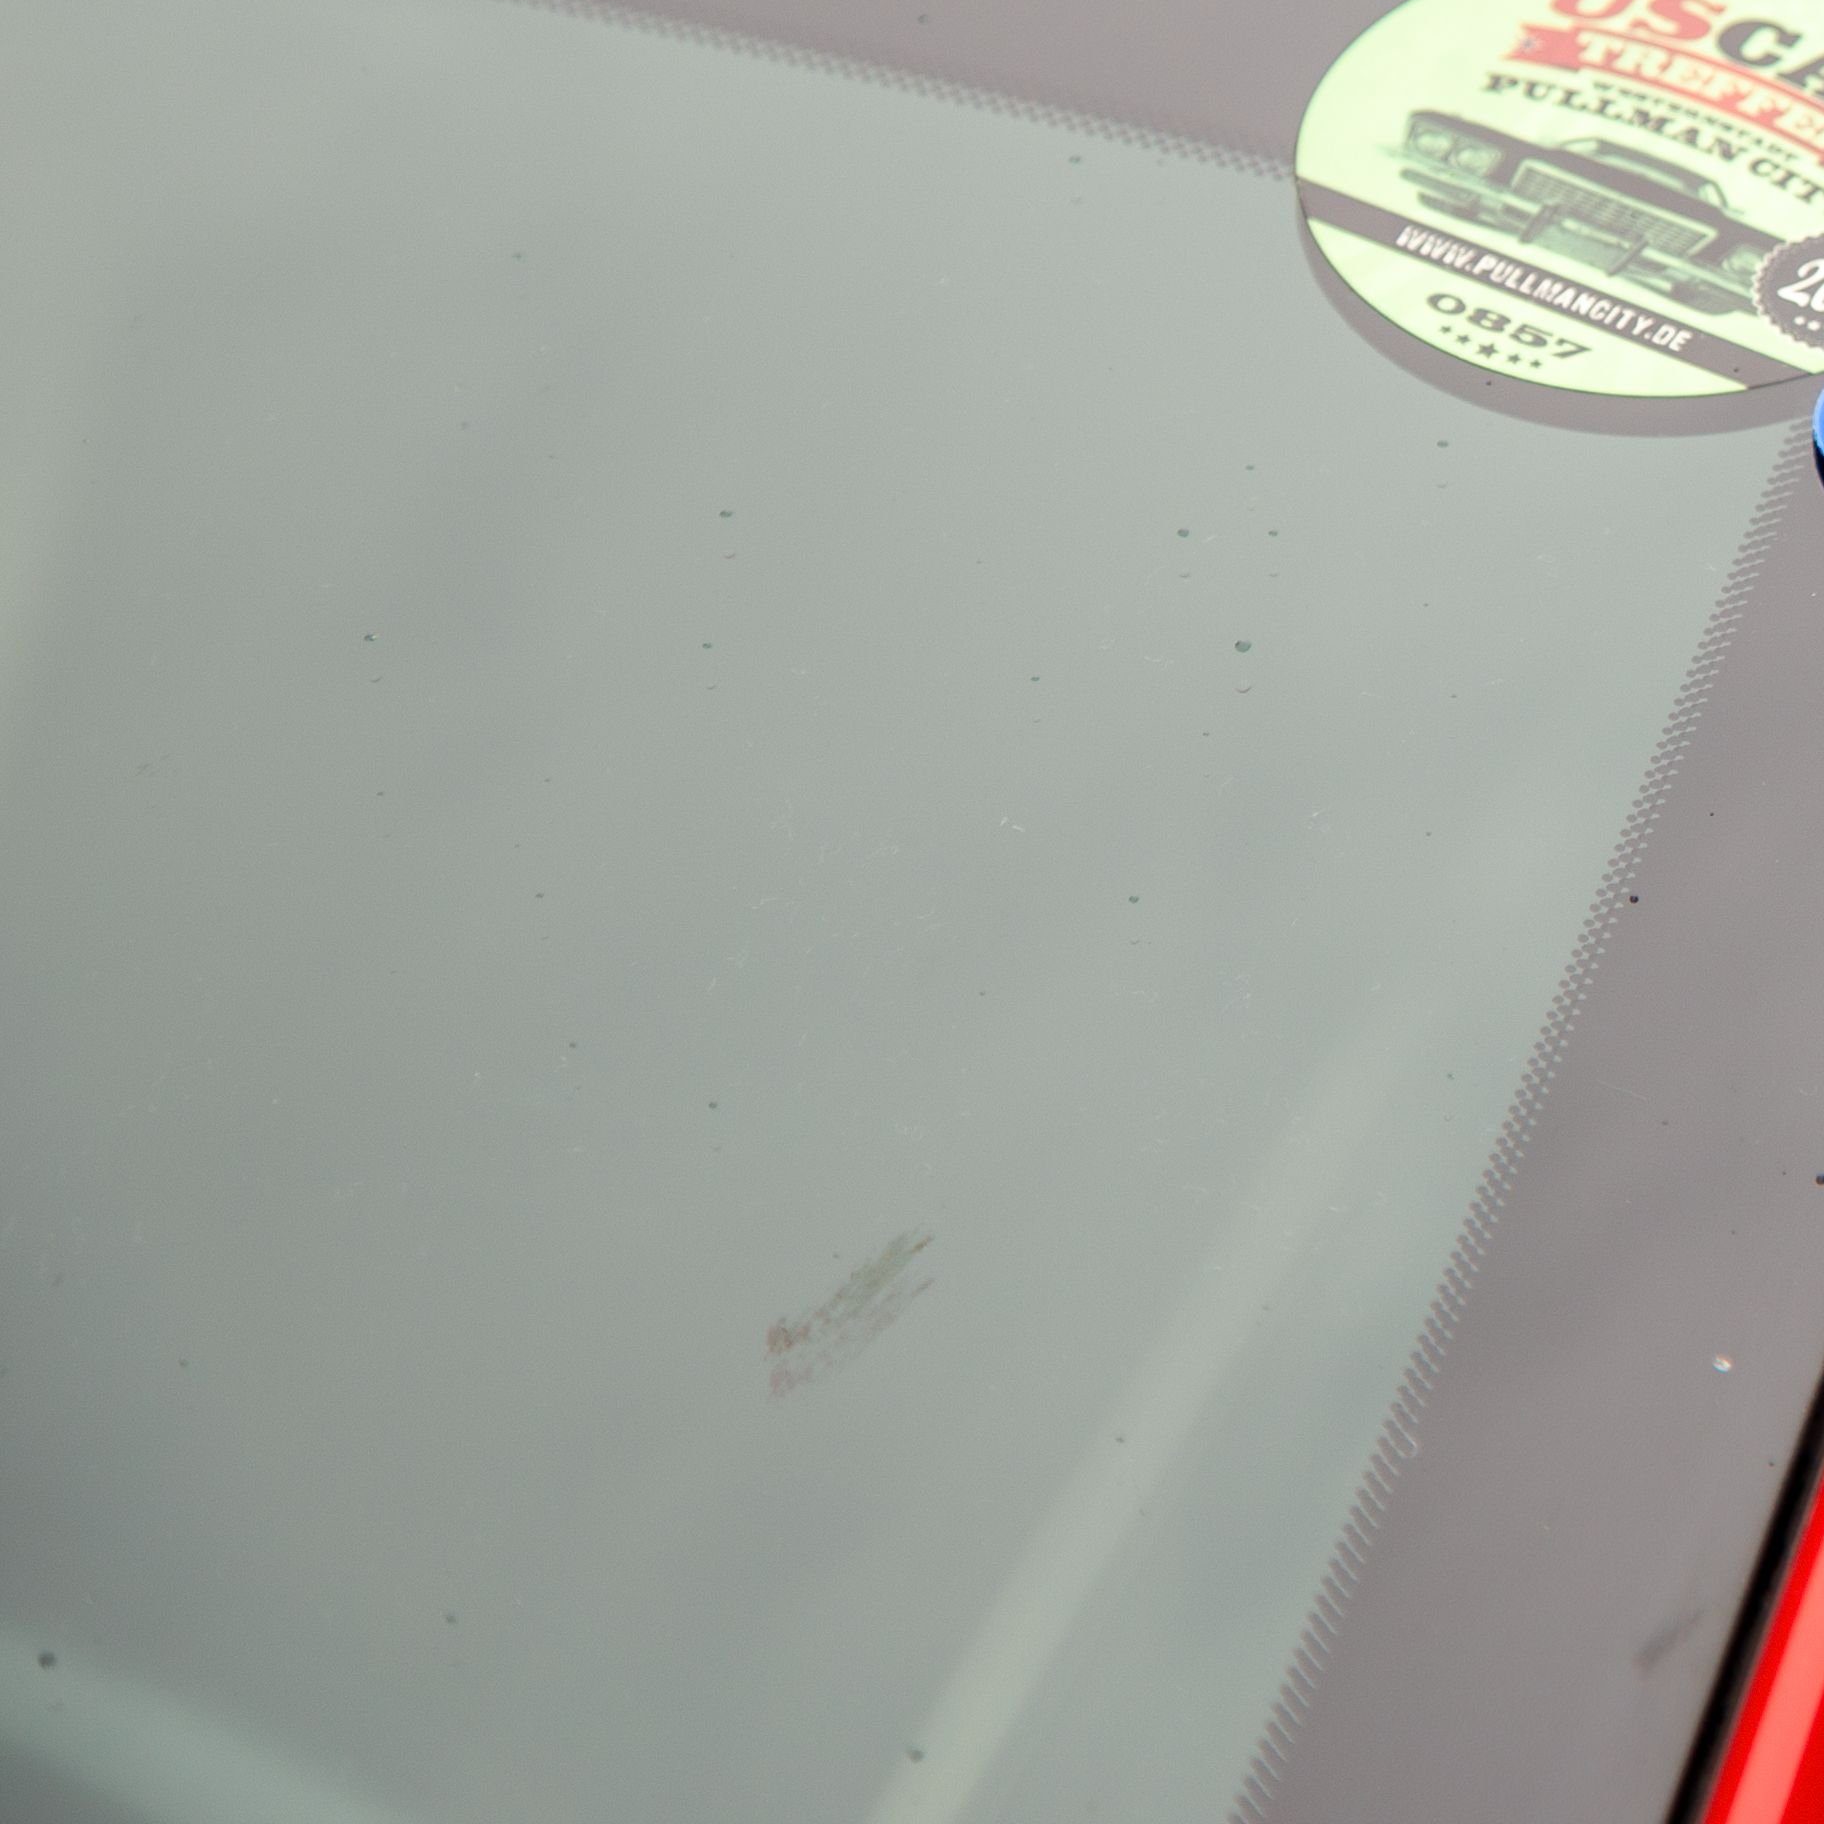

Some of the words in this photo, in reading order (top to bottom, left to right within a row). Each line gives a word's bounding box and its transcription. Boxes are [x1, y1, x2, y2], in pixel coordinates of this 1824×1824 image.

[1482, 73, 1747, 163] PULLMAN
[1395, 225, 1693, 353] WWW.PULLMANCITY.DE
[1427, 292, 1592, 359] 0857
